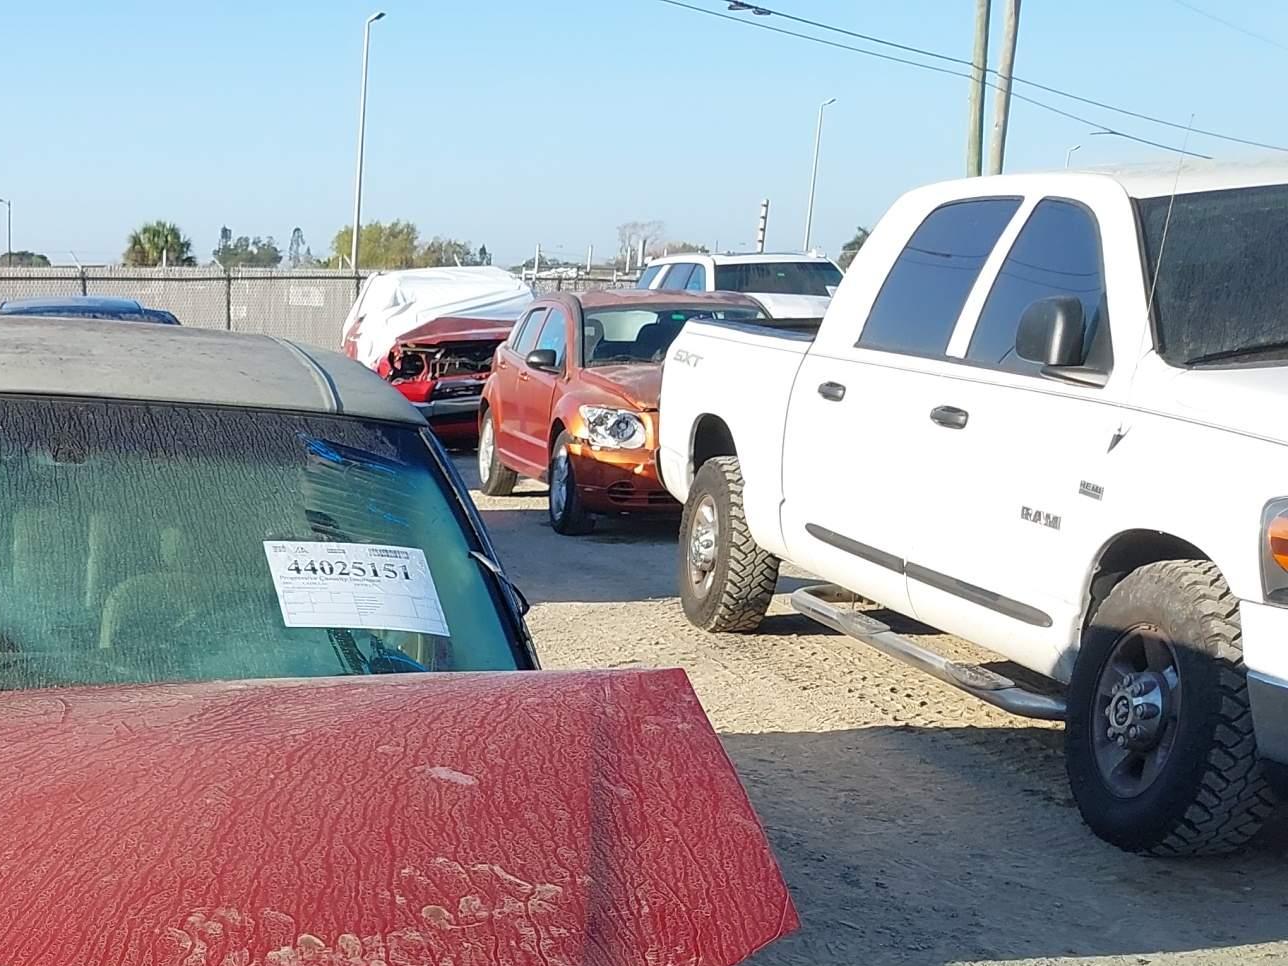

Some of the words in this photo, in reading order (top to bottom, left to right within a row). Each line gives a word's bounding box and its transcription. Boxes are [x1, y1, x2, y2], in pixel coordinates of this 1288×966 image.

[673, 349, 704, 367] SXT
[1021, 505, 1062, 530] RAM
[287, 559, 412, 581] 44025151
